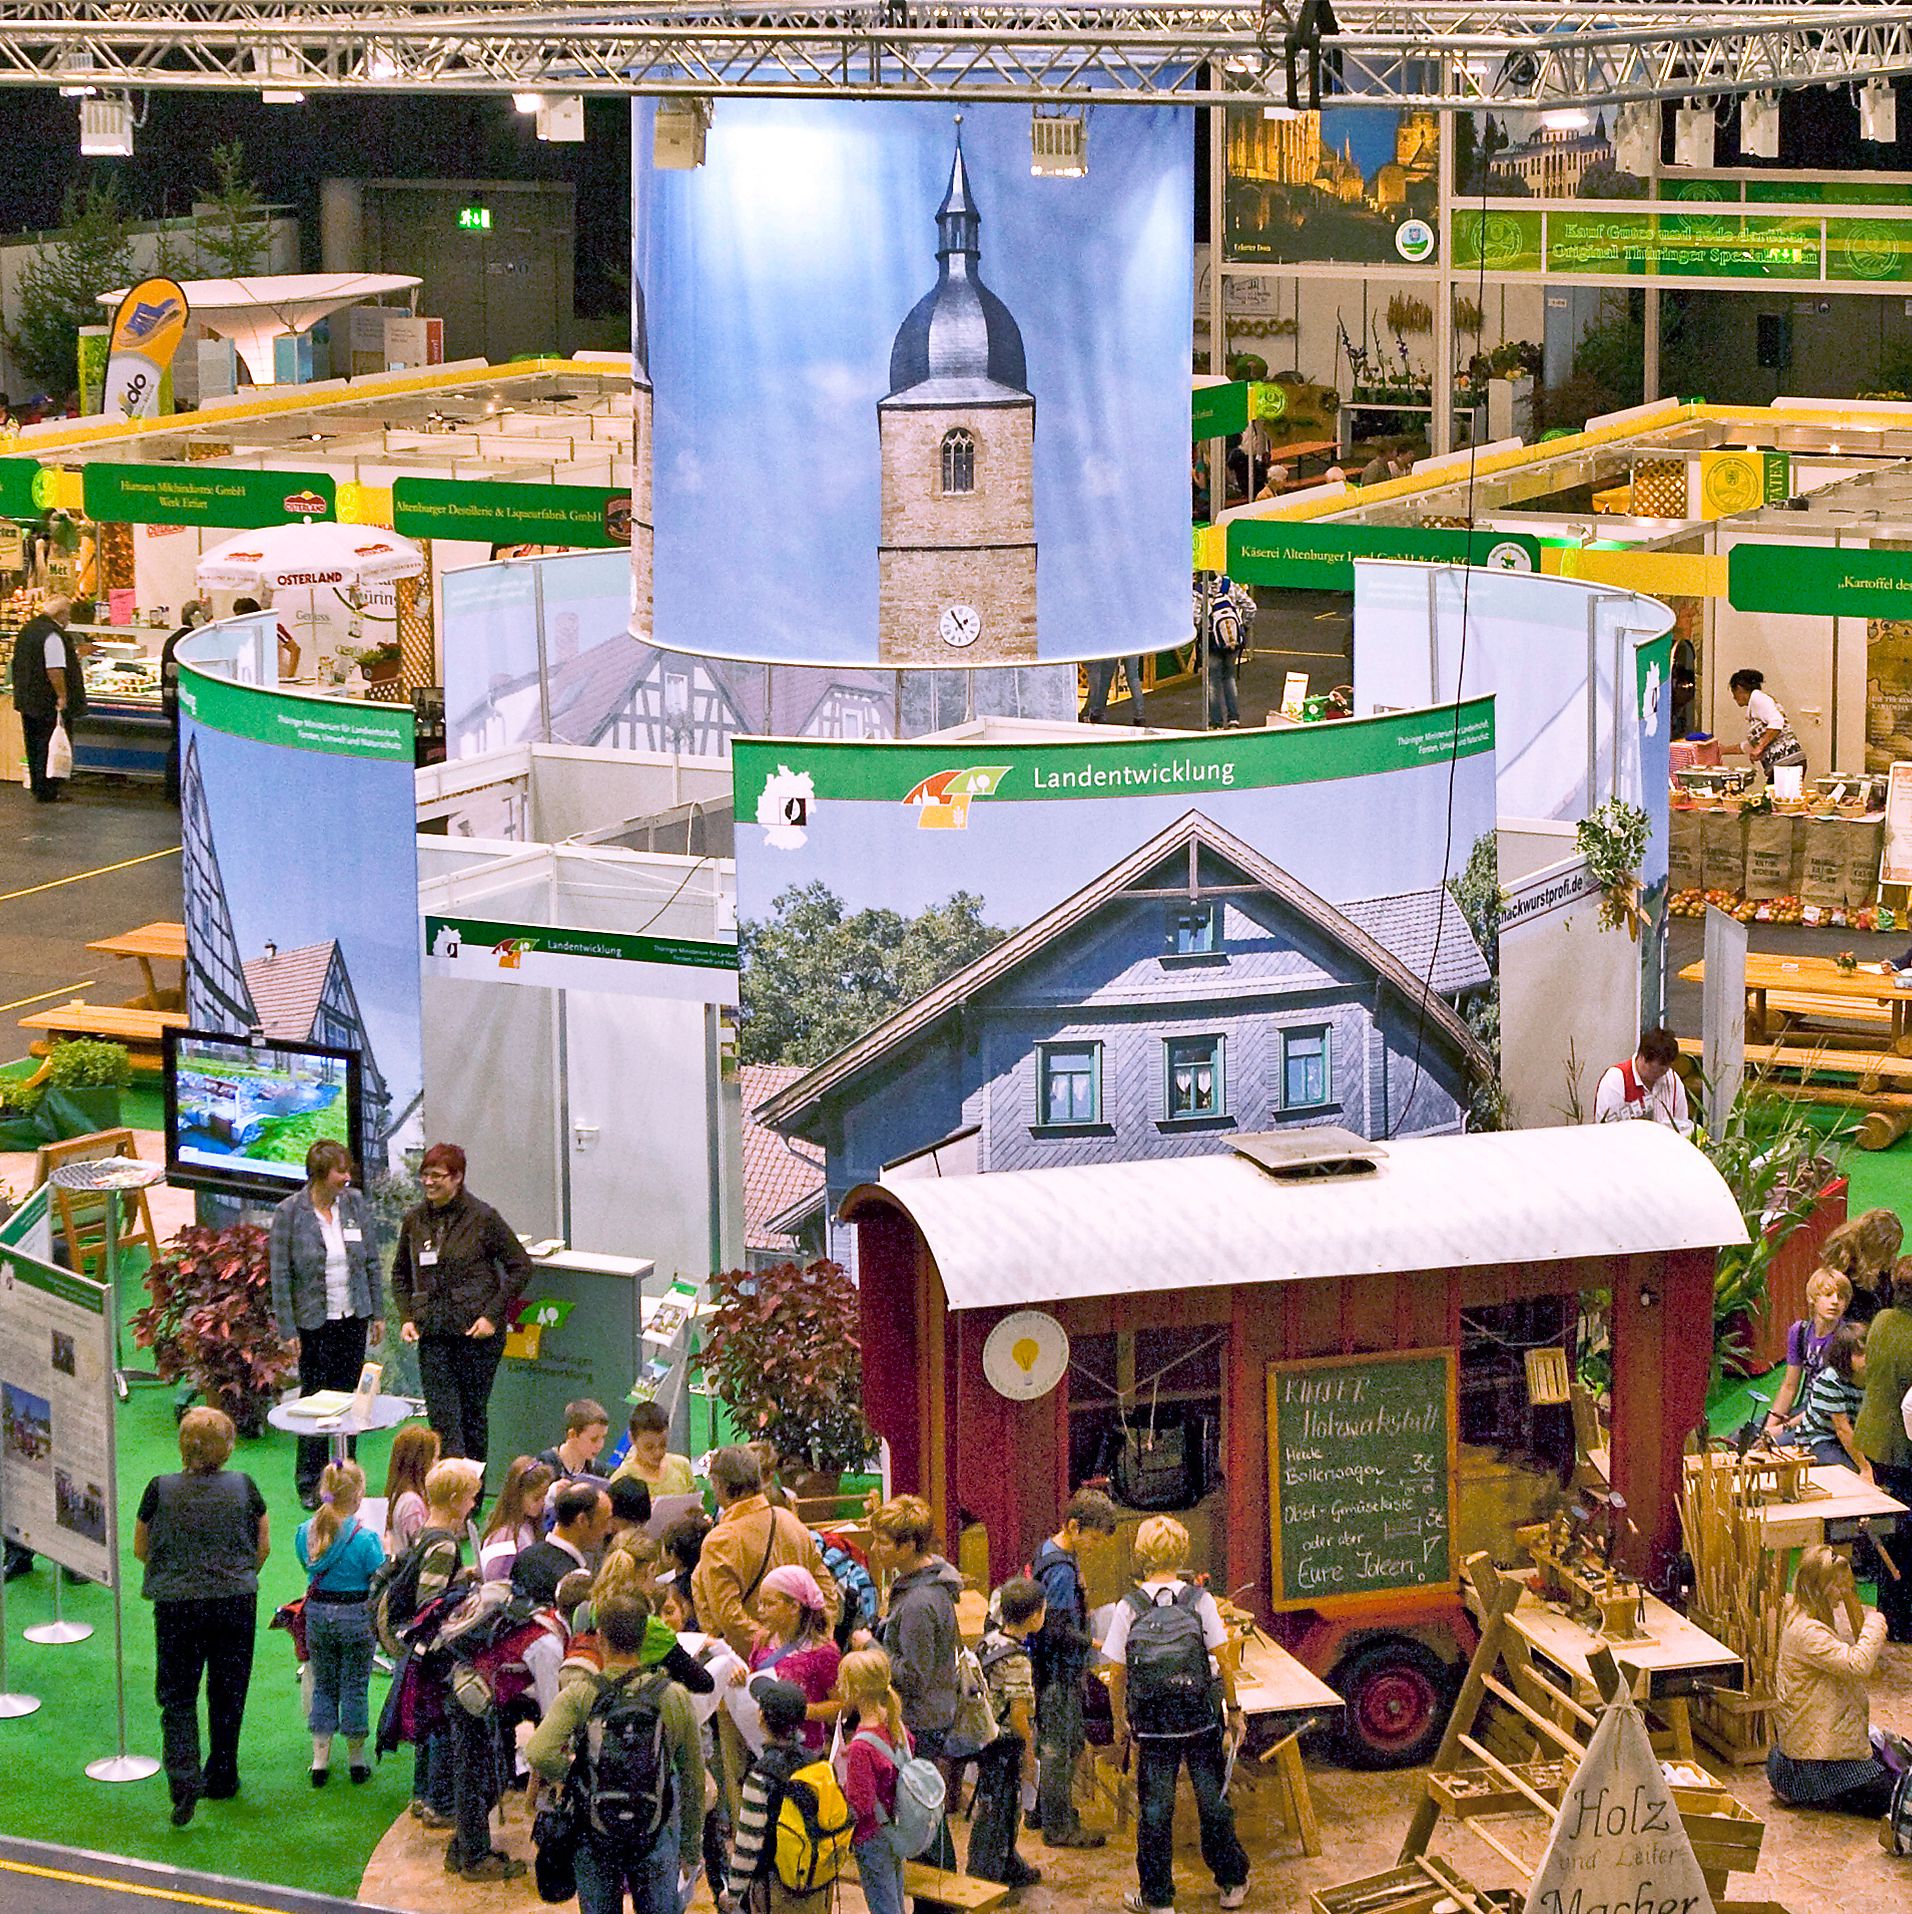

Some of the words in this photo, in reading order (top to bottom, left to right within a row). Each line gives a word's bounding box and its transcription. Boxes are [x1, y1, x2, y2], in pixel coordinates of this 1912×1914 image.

[1565, 224, 1605, 239] Kauf
[1607, 225, 1655, 240] Gutes
[1658, 227, 1692, 241] und
[1695, 226, 1734, 242] rede
[1552, 243, 1619, 262] Original
[1623, 245, 1706, 265] Thüringer
[1710, 248, 1818, 266] Spezialen
[215, 484, 246, 496] GmbH
[285, 502, 325, 513] OSTERLAND
[396, 501, 446, 516] Altenburger
[495, 507, 505, 518] &
[569, 510, 602, 522] GmbH
[1241, 545, 1280, 559] Käserei
[1283, 547, 1345, 564] Altenburger
[277, 571, 343, 586] OSTERLAND
[1838, 576, 1893, 590] „Kartoffel
[1033, 760, 1235, 789] Landentwicklung
[1499, 874, 1584, 924] nackwurstprofi.de
[547, 939, 623, 958] Landentwicklung
[1285, 1446, 1324, 1462] Heute
[1285, 1465, 1385, 1486] Bollerwagen
[1302, 1534, 1333, 1551] oder
[1338, 1531, 1365, 1546] aber
[1297, 1557, 1345, 1588] Eure
[1569, 1785, 1670, 1839] Holz
[1560, 1848, 1602, 1871] und
[1615, 1846, 1677, 1868] Leiter
